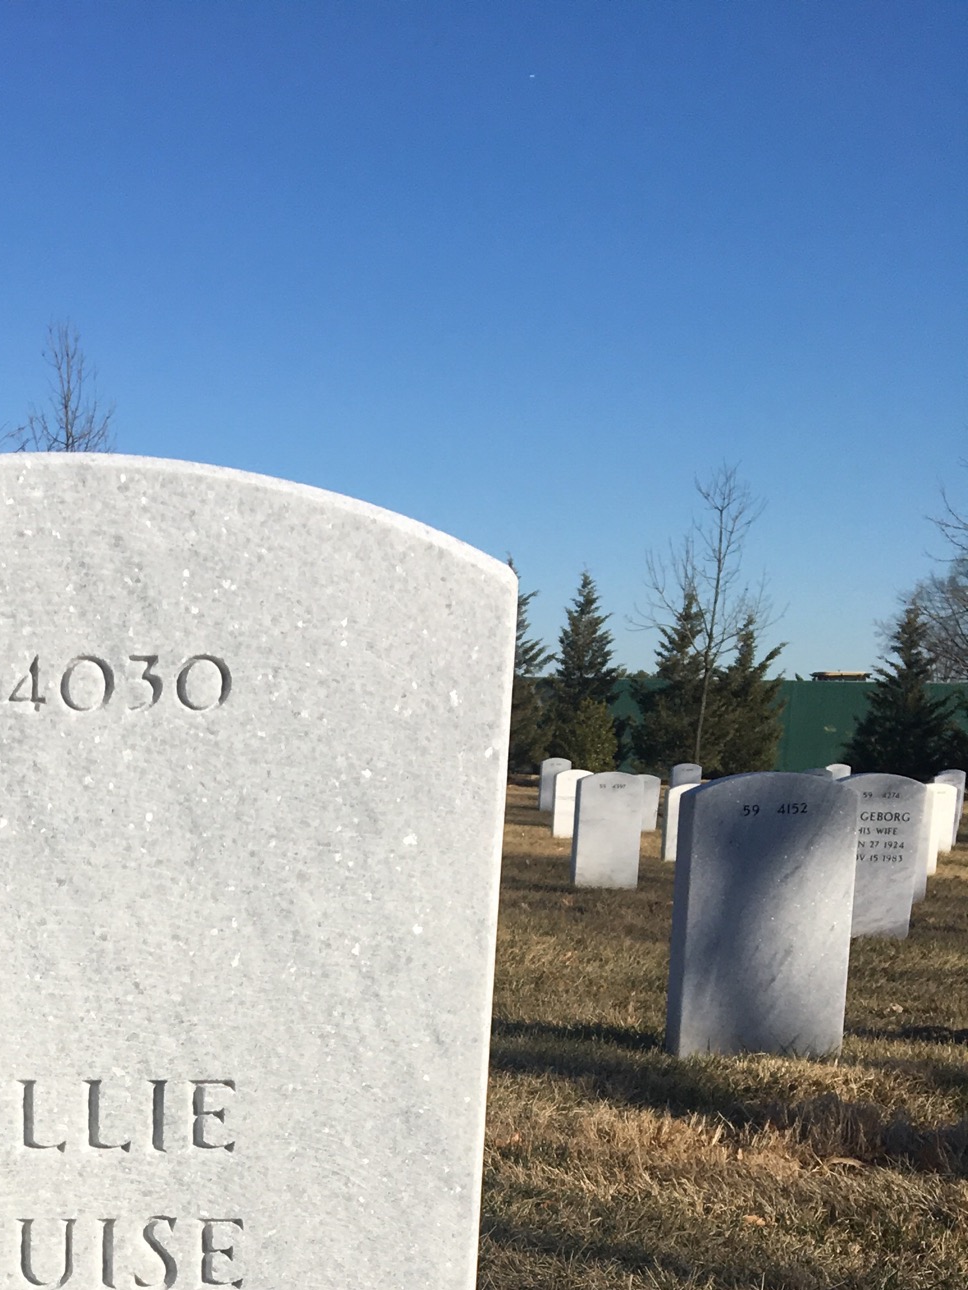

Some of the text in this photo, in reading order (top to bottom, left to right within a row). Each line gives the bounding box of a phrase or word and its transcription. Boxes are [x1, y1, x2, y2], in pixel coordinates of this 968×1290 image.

[8, 654, 234, 712] 4030
[862, 791, 873, 799] 59
[743, 802, 808, 816] 59 4152
[859, 811, 911, 822] GEBORG
[875, 827, 899, 836] WIFE
[869, 840, 880, 848] 27
[883, 840, 905, 849] 1924
[869, 854, 879, 862] 15
[882, 854, 903, 863] 1983
